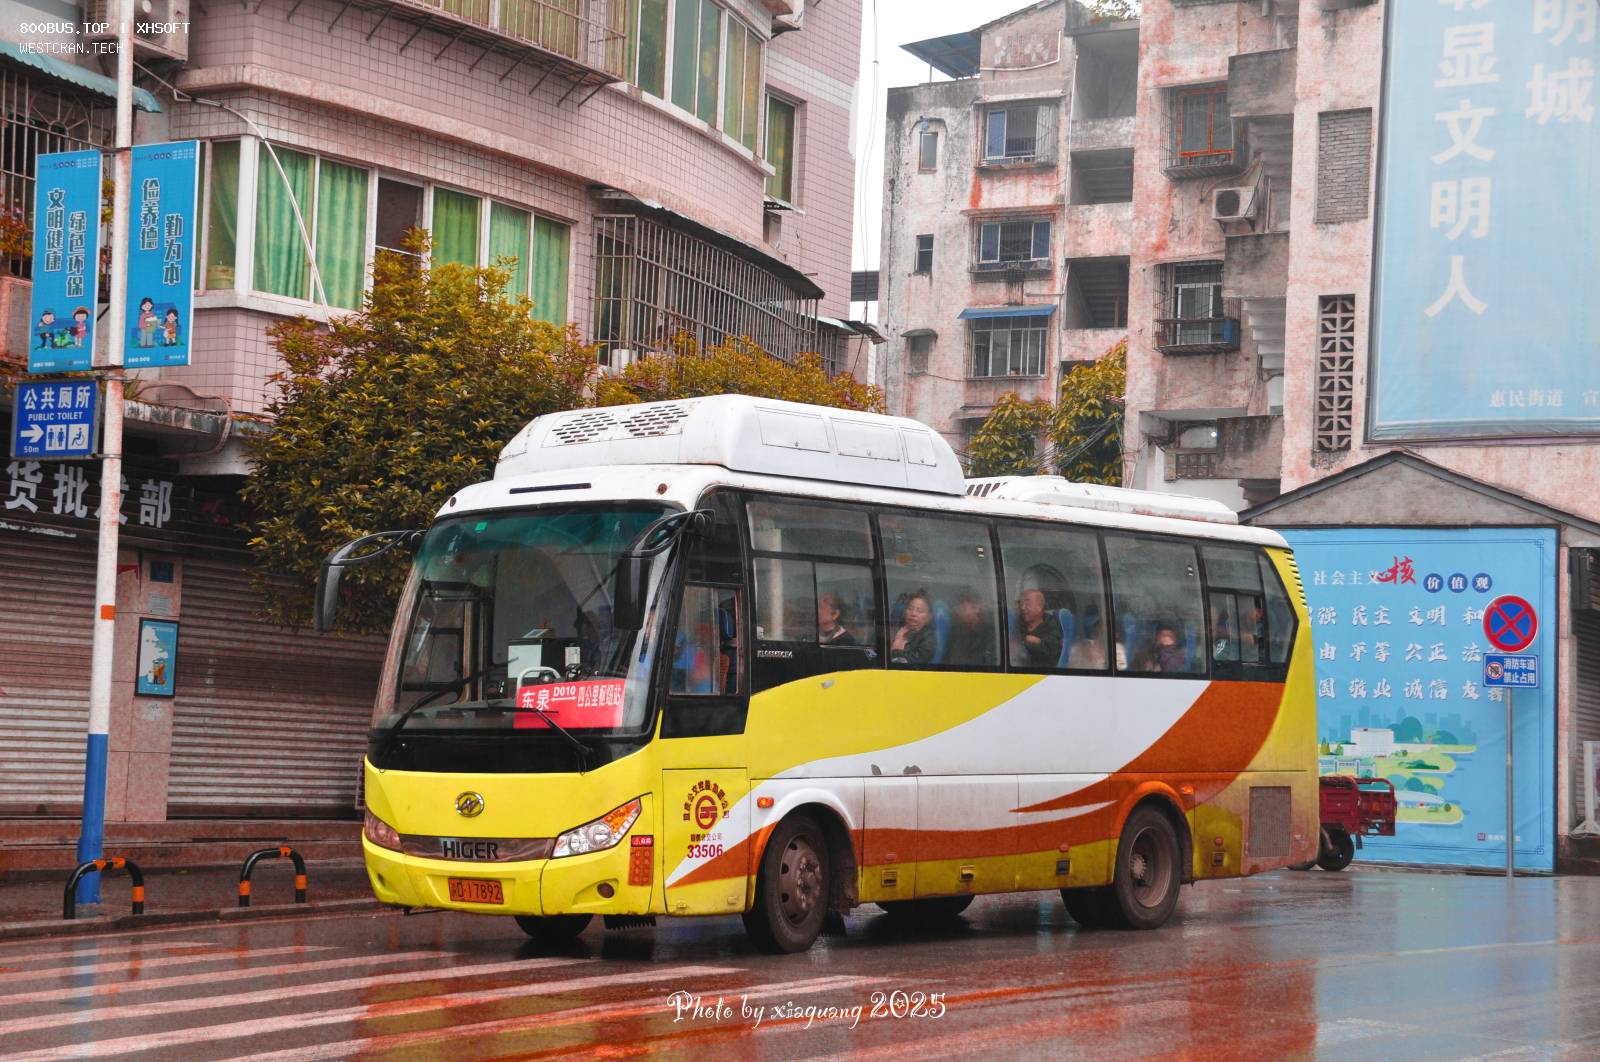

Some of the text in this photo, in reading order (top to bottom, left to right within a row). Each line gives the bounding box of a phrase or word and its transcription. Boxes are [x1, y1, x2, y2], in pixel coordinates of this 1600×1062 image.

[1424, 0, 1500, 318] 显文明人
[163, 213, 184, 285] 勤为本
[24, 386, 91, 410] 公共厕所
[28, 411, 83, 421] PUBLIC TOILET
[24, 445, 39, 453] 50m
[1427, 576, 1489, 590] 价值观
[1351, 604, 1391, 626] 民主
[1408, 604, 1447, 626] 文明
[1350, 641, 1391, 662] 平等
[1405, 642, 1448, 662] 公正
[1503, 672, 1535, 684] 禁止占用
[521, 688, 549, 710] 东泉
[553, 686, 576, 696] D010
[1404, 679, 1448, 700] 诚信
[443, 841, 498, 859] HIGER
[687, 844, 724, 858] 33506
